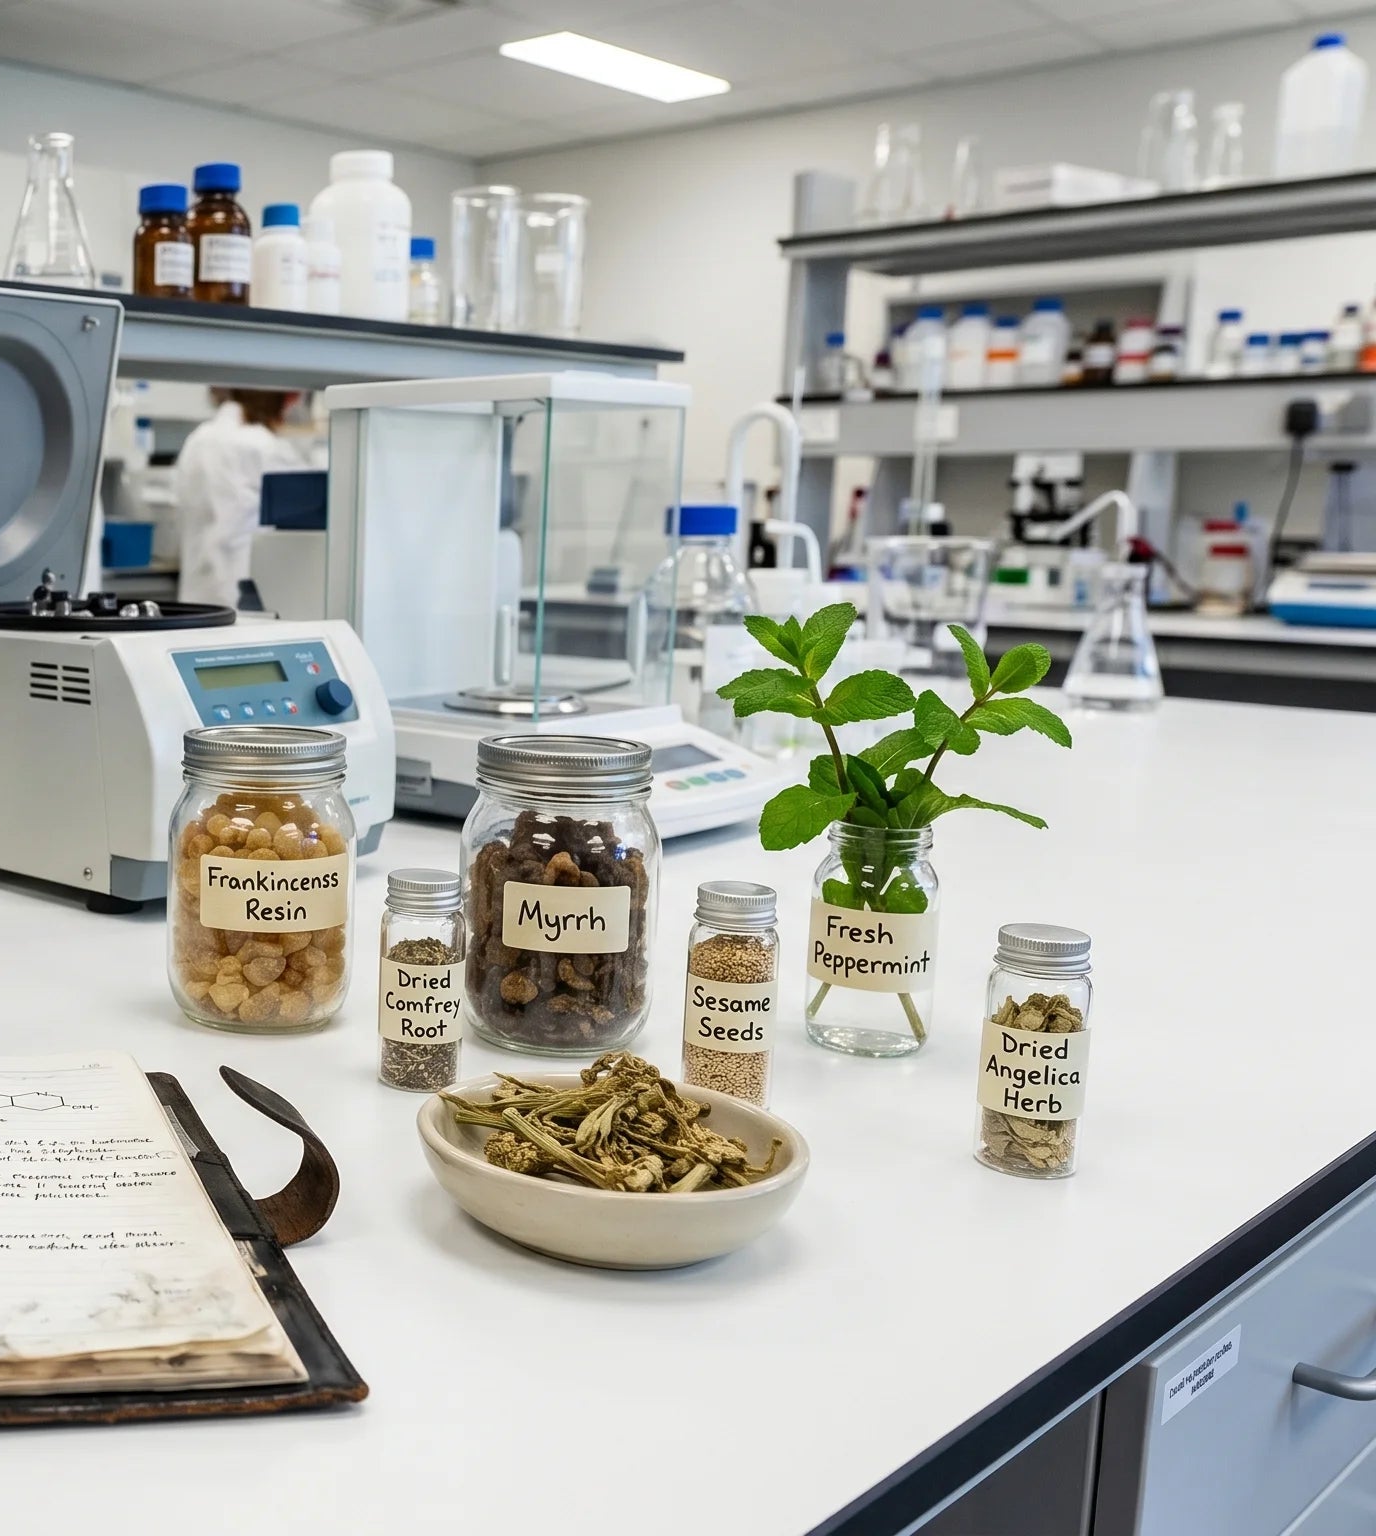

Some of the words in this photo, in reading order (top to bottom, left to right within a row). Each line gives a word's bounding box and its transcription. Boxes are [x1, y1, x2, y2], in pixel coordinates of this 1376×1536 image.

[207, 866, 340, 892] Frankincenss
[245, 897, 308, 921] Resin
[517, 899, 607, 942] Myrrh
[826, 915, 895, 945] Fresh
[813, 940, 931, 979] Peppermint
[396, 968, 452, 990] Dried
[385, 991, 461, 1019] Comfrey
[691, 985, 772, 1013] Sesame
[400, 1017, 448, 1039] Root
[697, 1016, 765, 1041] Seeds
[1001, 1031, 1069, 1060] Dried
[985, 1054, 1081, 1090] Angelica
[1003, 1087, 1063, 1114] Herb
